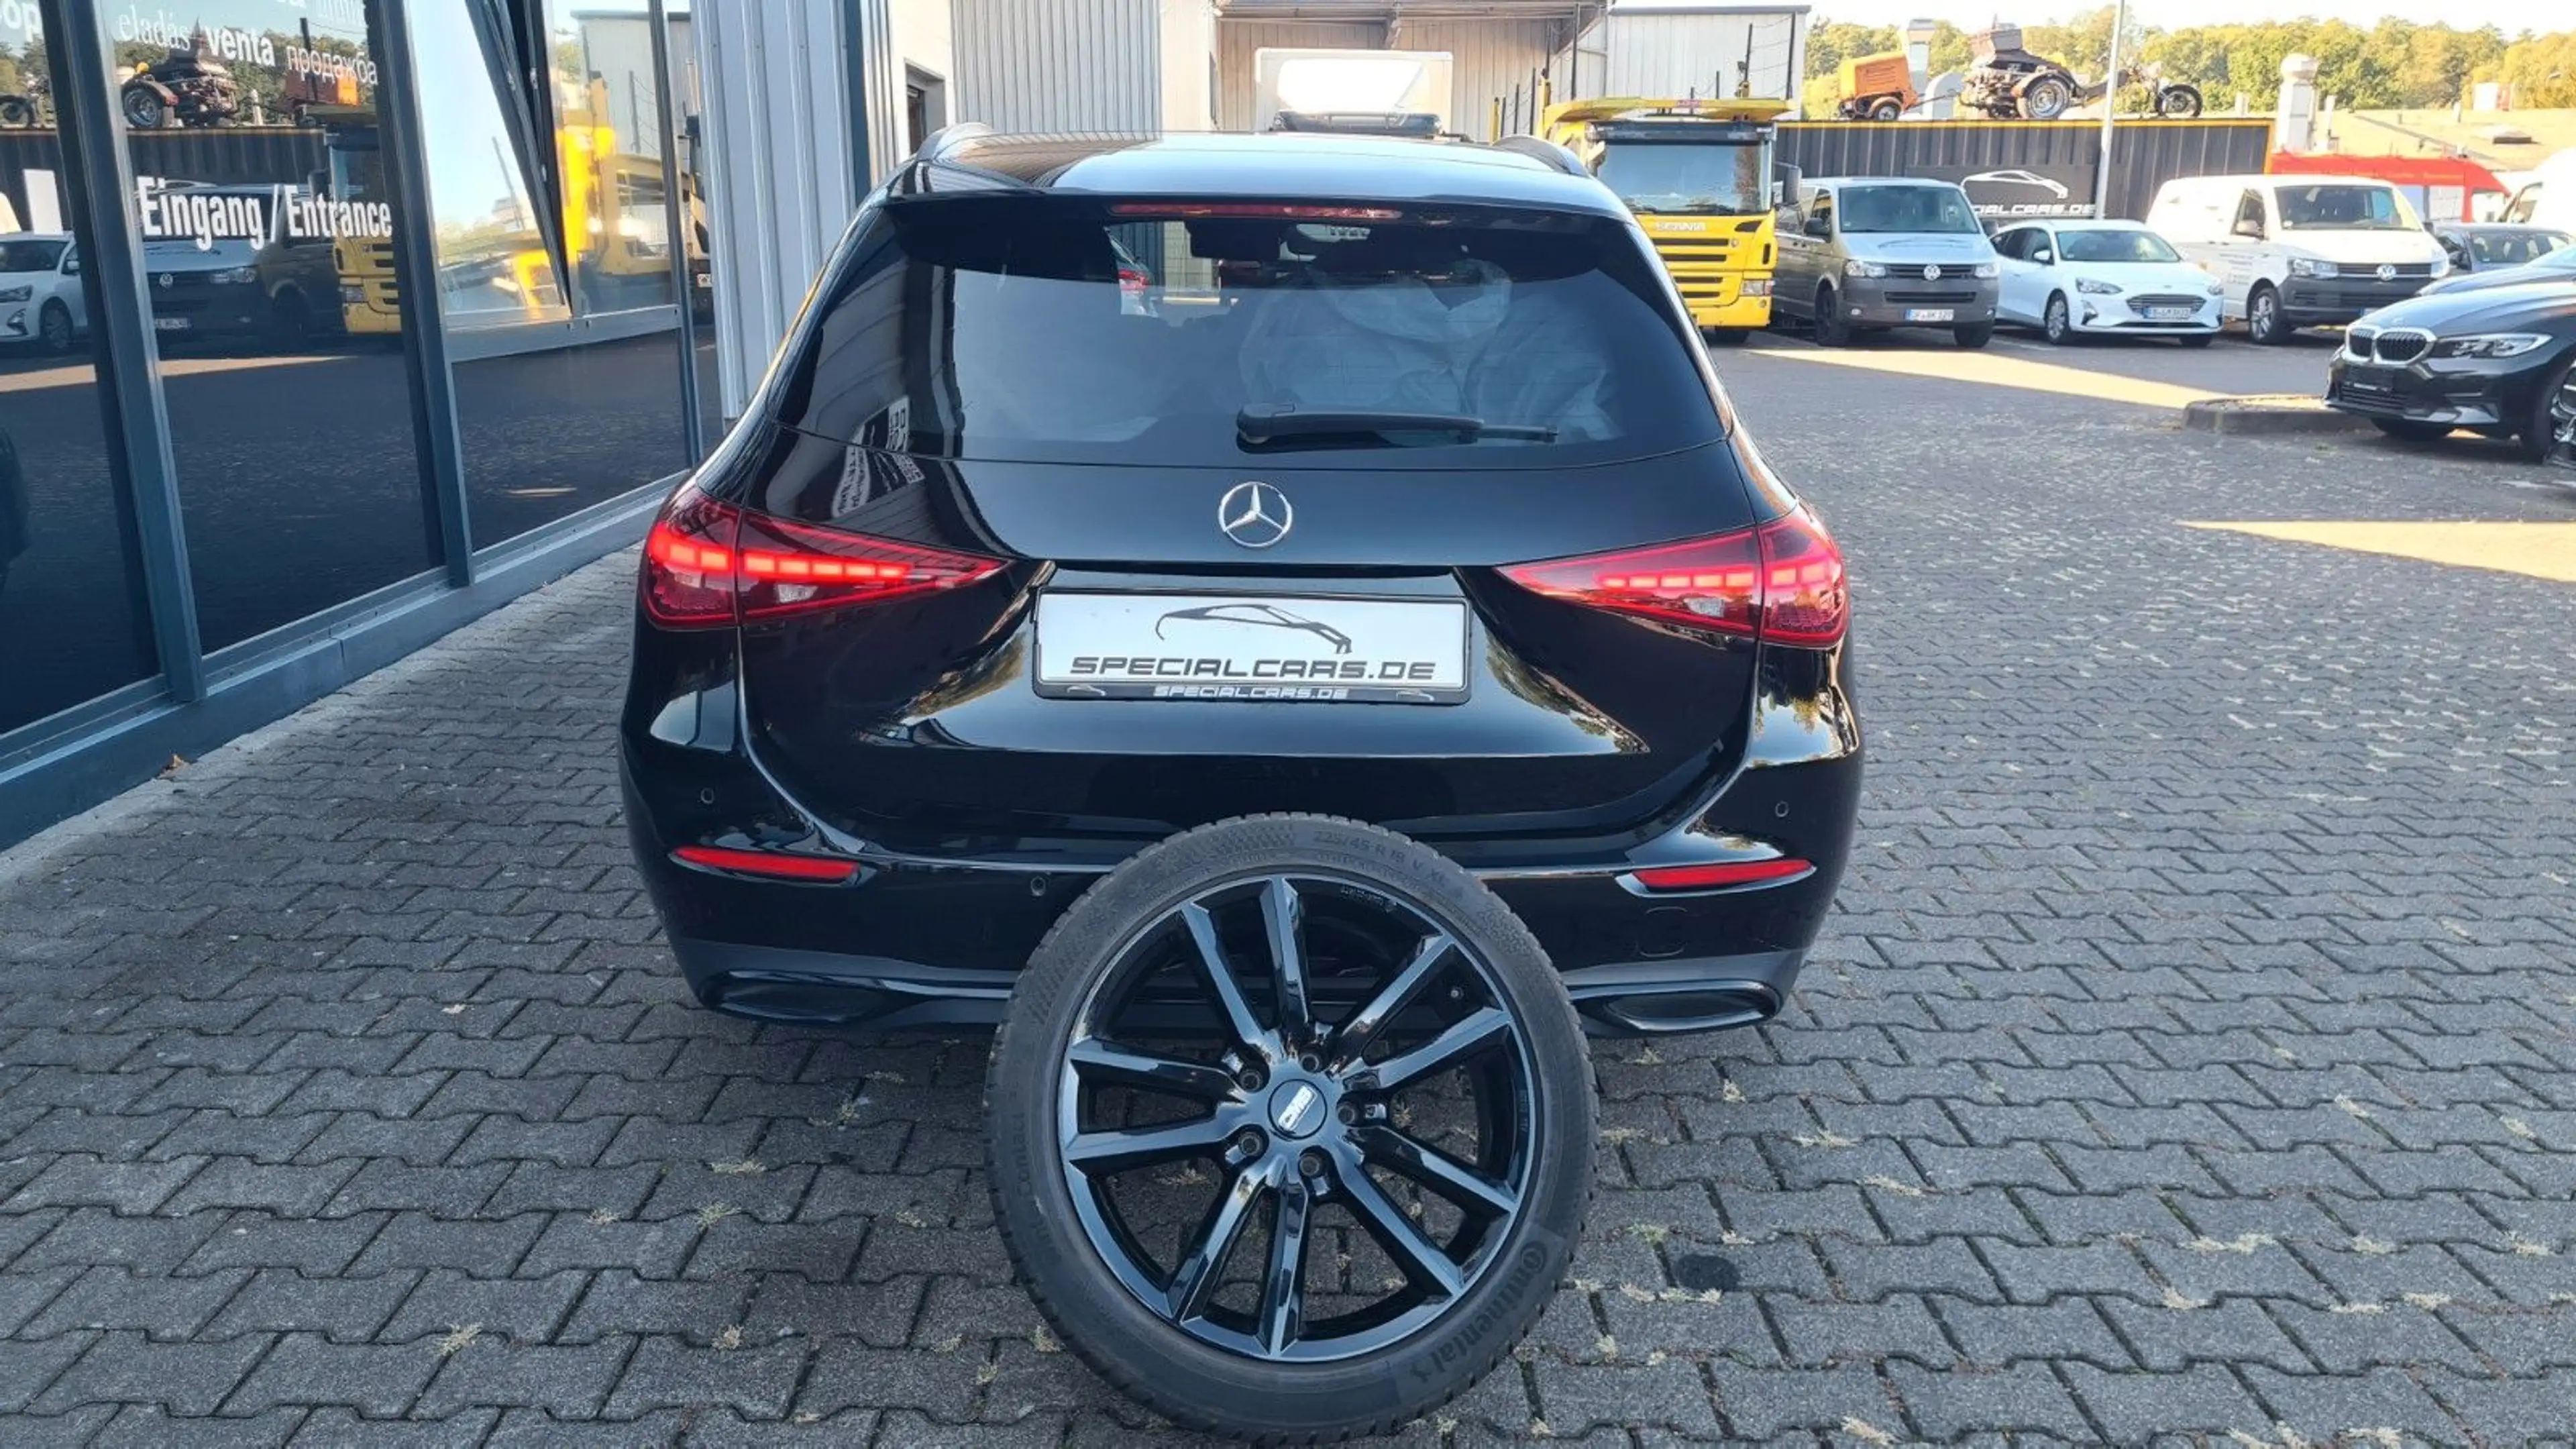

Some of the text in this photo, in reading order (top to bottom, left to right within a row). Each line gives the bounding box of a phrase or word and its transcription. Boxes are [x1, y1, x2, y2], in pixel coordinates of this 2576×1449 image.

[0, 0, 42, 42] op
[203, 25, 276, 67] venta
[286, 45, 378, 86] продажба
[137, 176, 265, 251] Eingang
[284, 185, 392, 237] Entrance
[1070, 657, 1436, 680] SPECIALCARS.DE
[1153, 684, 1347, 700] SPECIALCARS.DE
[1429, 1240, 1548, 1373] Continental
